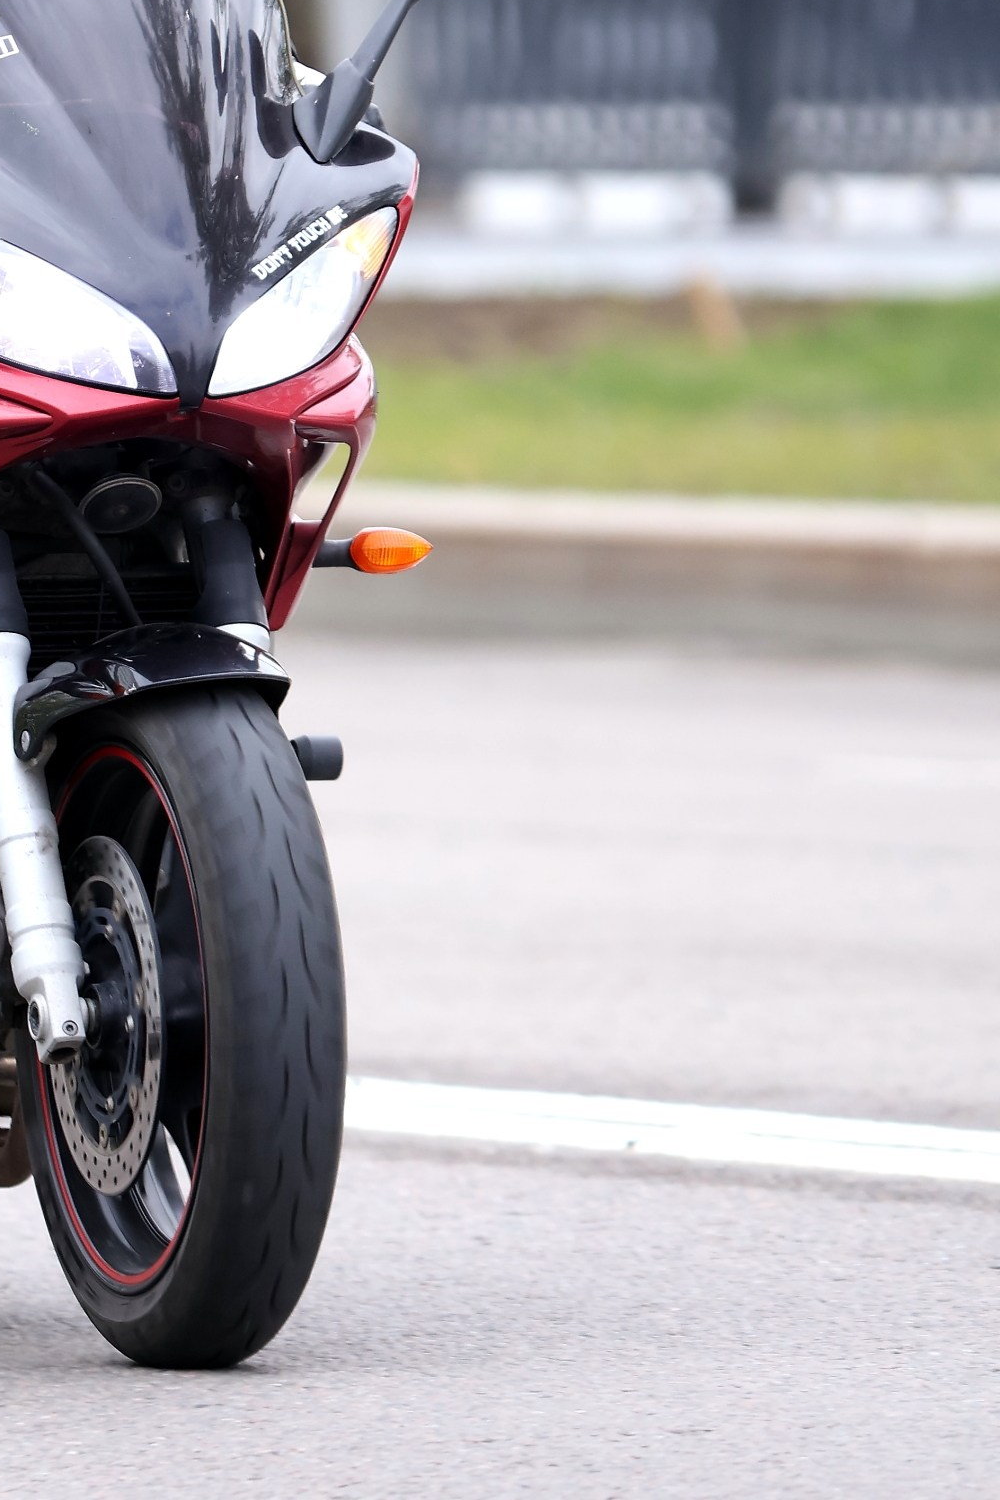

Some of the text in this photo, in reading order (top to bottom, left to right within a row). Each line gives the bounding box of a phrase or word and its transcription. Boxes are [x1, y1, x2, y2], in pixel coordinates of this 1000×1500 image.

[251, 205, 348, 281] DON'T TOUCH ME
